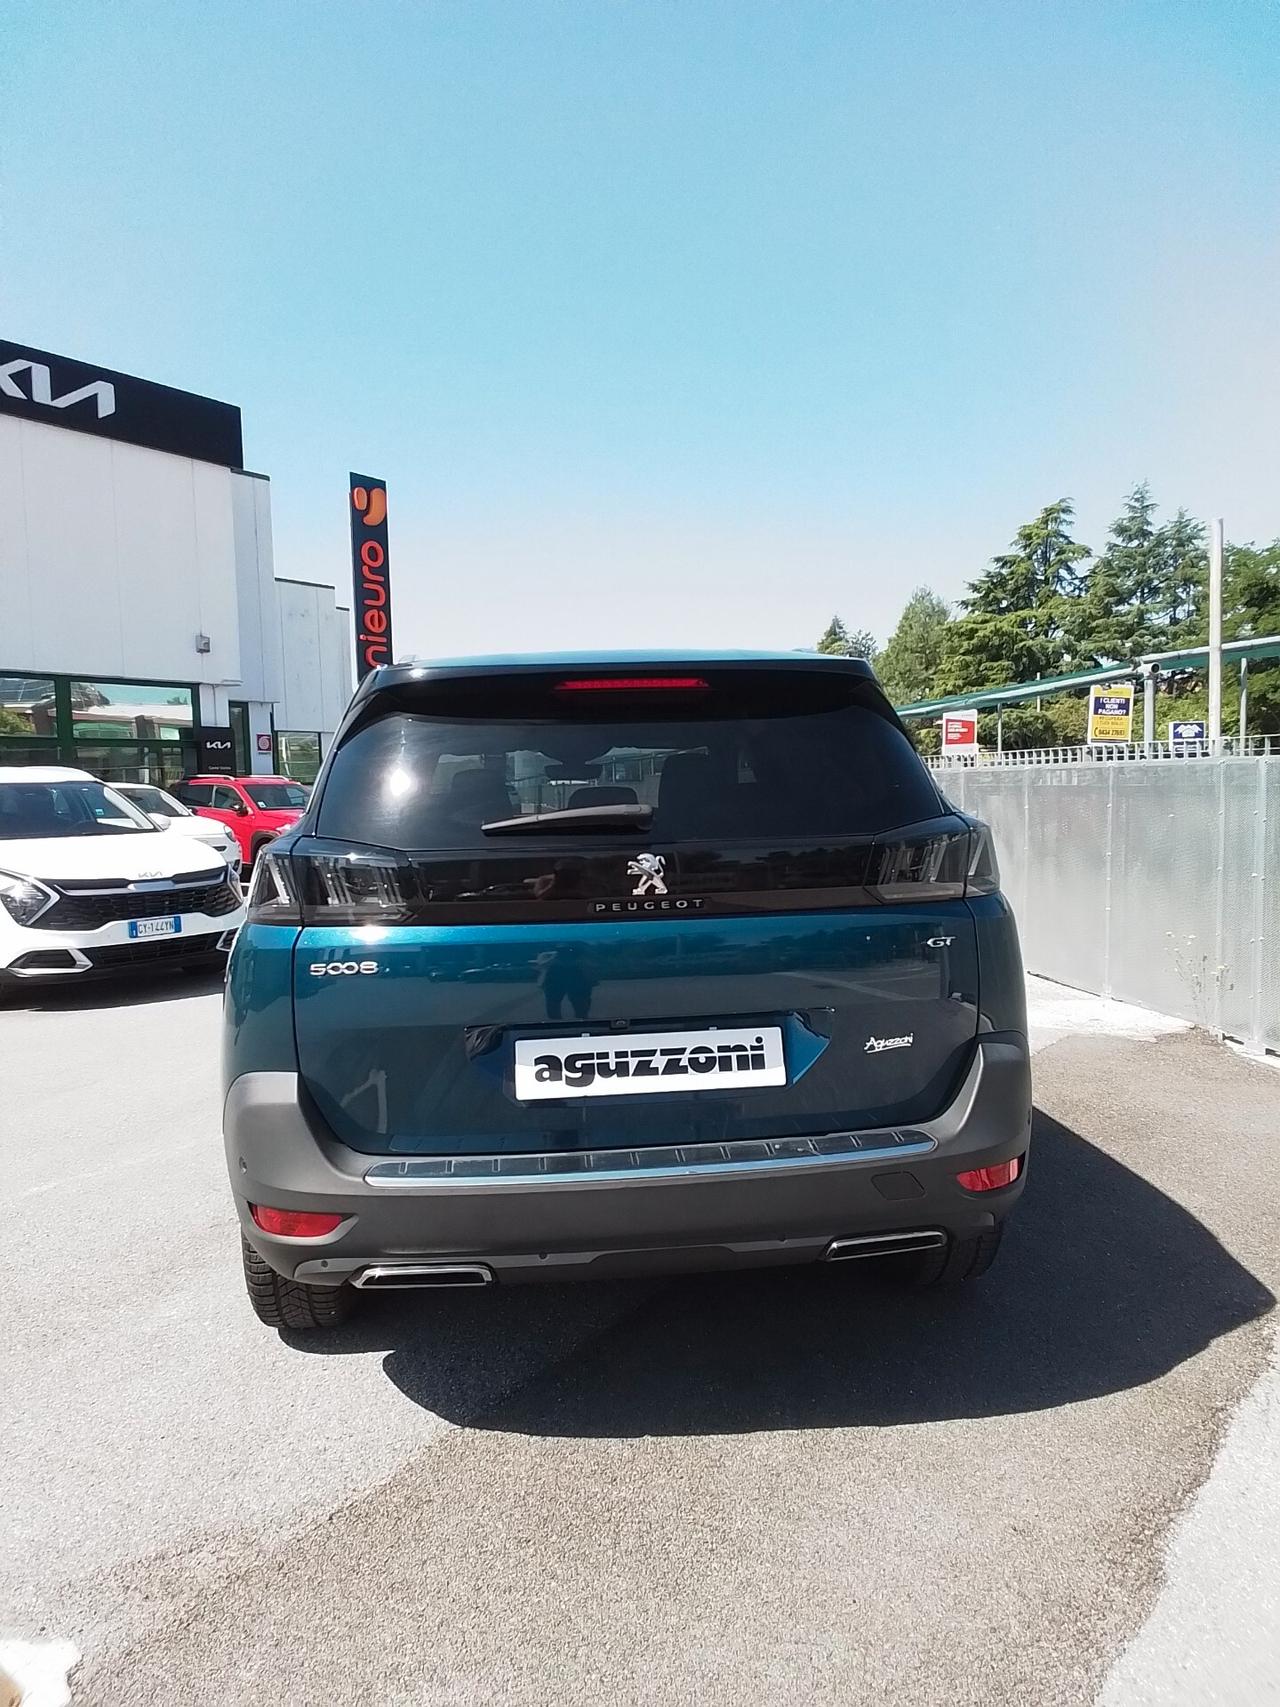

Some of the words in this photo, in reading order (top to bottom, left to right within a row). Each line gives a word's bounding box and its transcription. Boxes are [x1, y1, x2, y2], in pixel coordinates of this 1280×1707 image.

[206, 741, 231, 749] KIA
[595, 899, 703, 912] PEUGEOT
[926, 936, 957, 948] GT
[310, 961, 379, 976] 5008
[534, 1036, 767, 1088] aguzzoni
